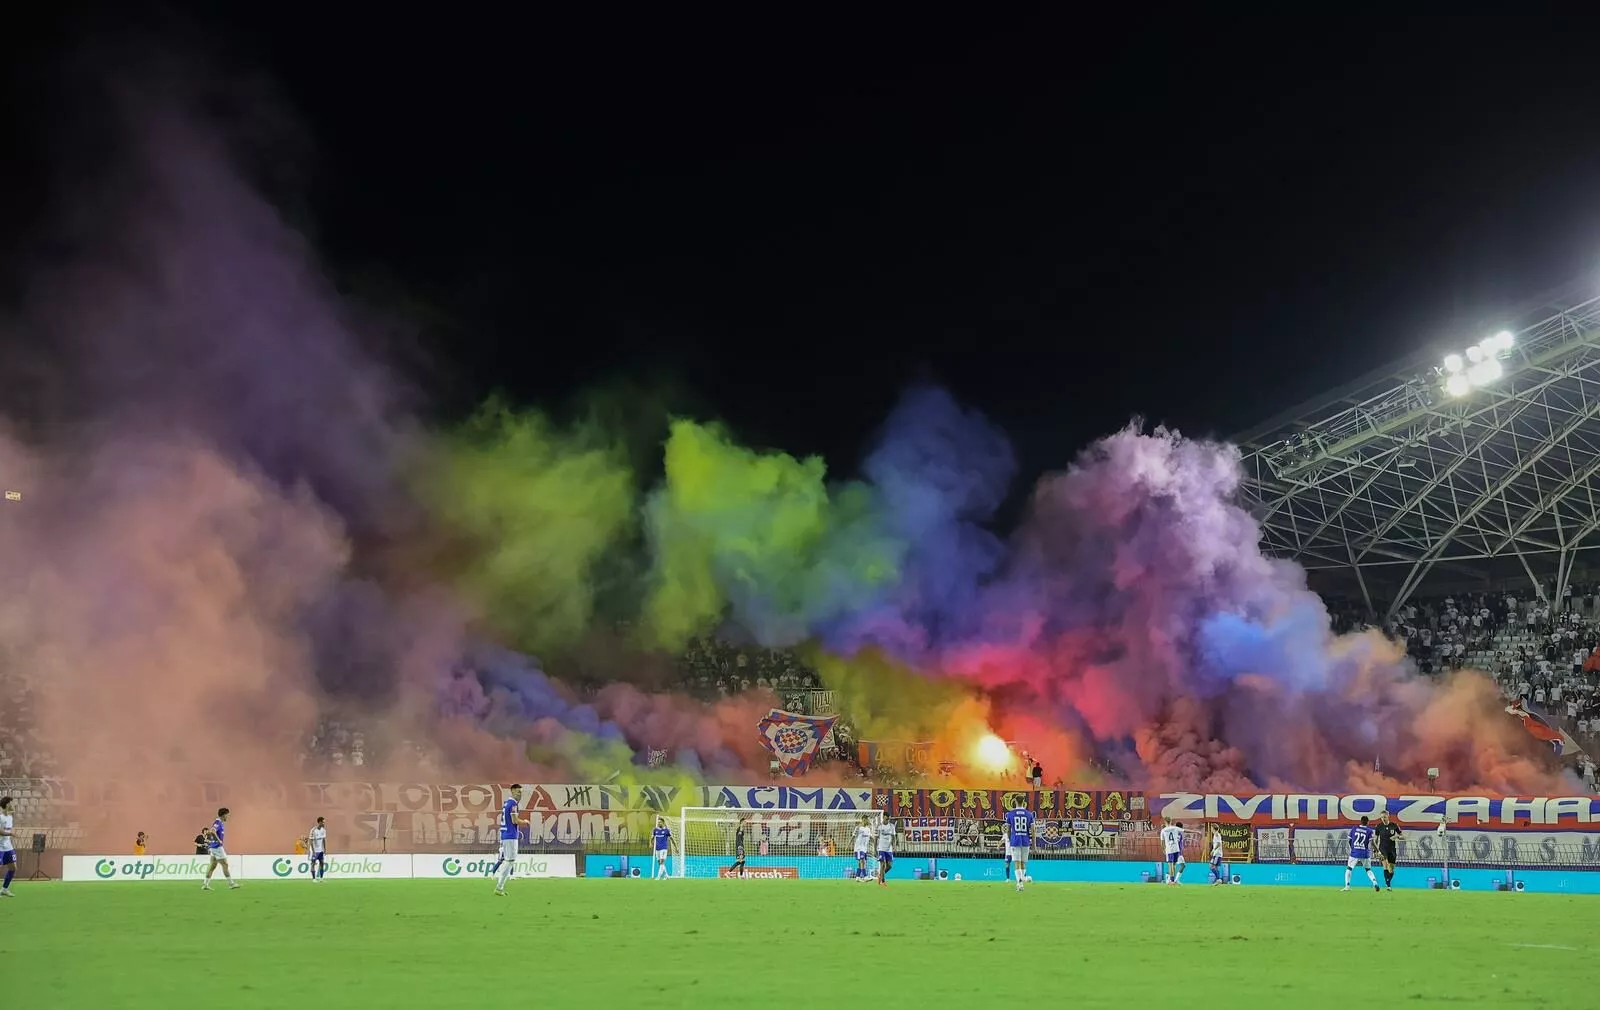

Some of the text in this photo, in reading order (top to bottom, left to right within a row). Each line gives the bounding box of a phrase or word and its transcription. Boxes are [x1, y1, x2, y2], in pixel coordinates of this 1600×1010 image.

[893, 789, 1126, 811] TORCIDA
[1160, 792, 1600, 825] ŽIVIMO ZA HA
[1014, 816, 1027, 832] 88
[1168, 831, 1175, 844] 4
[1353, 832, 1367, 847] 22
[297, 857, 382, 877] opbanka
[466, 857, 548, 877] otpanka
